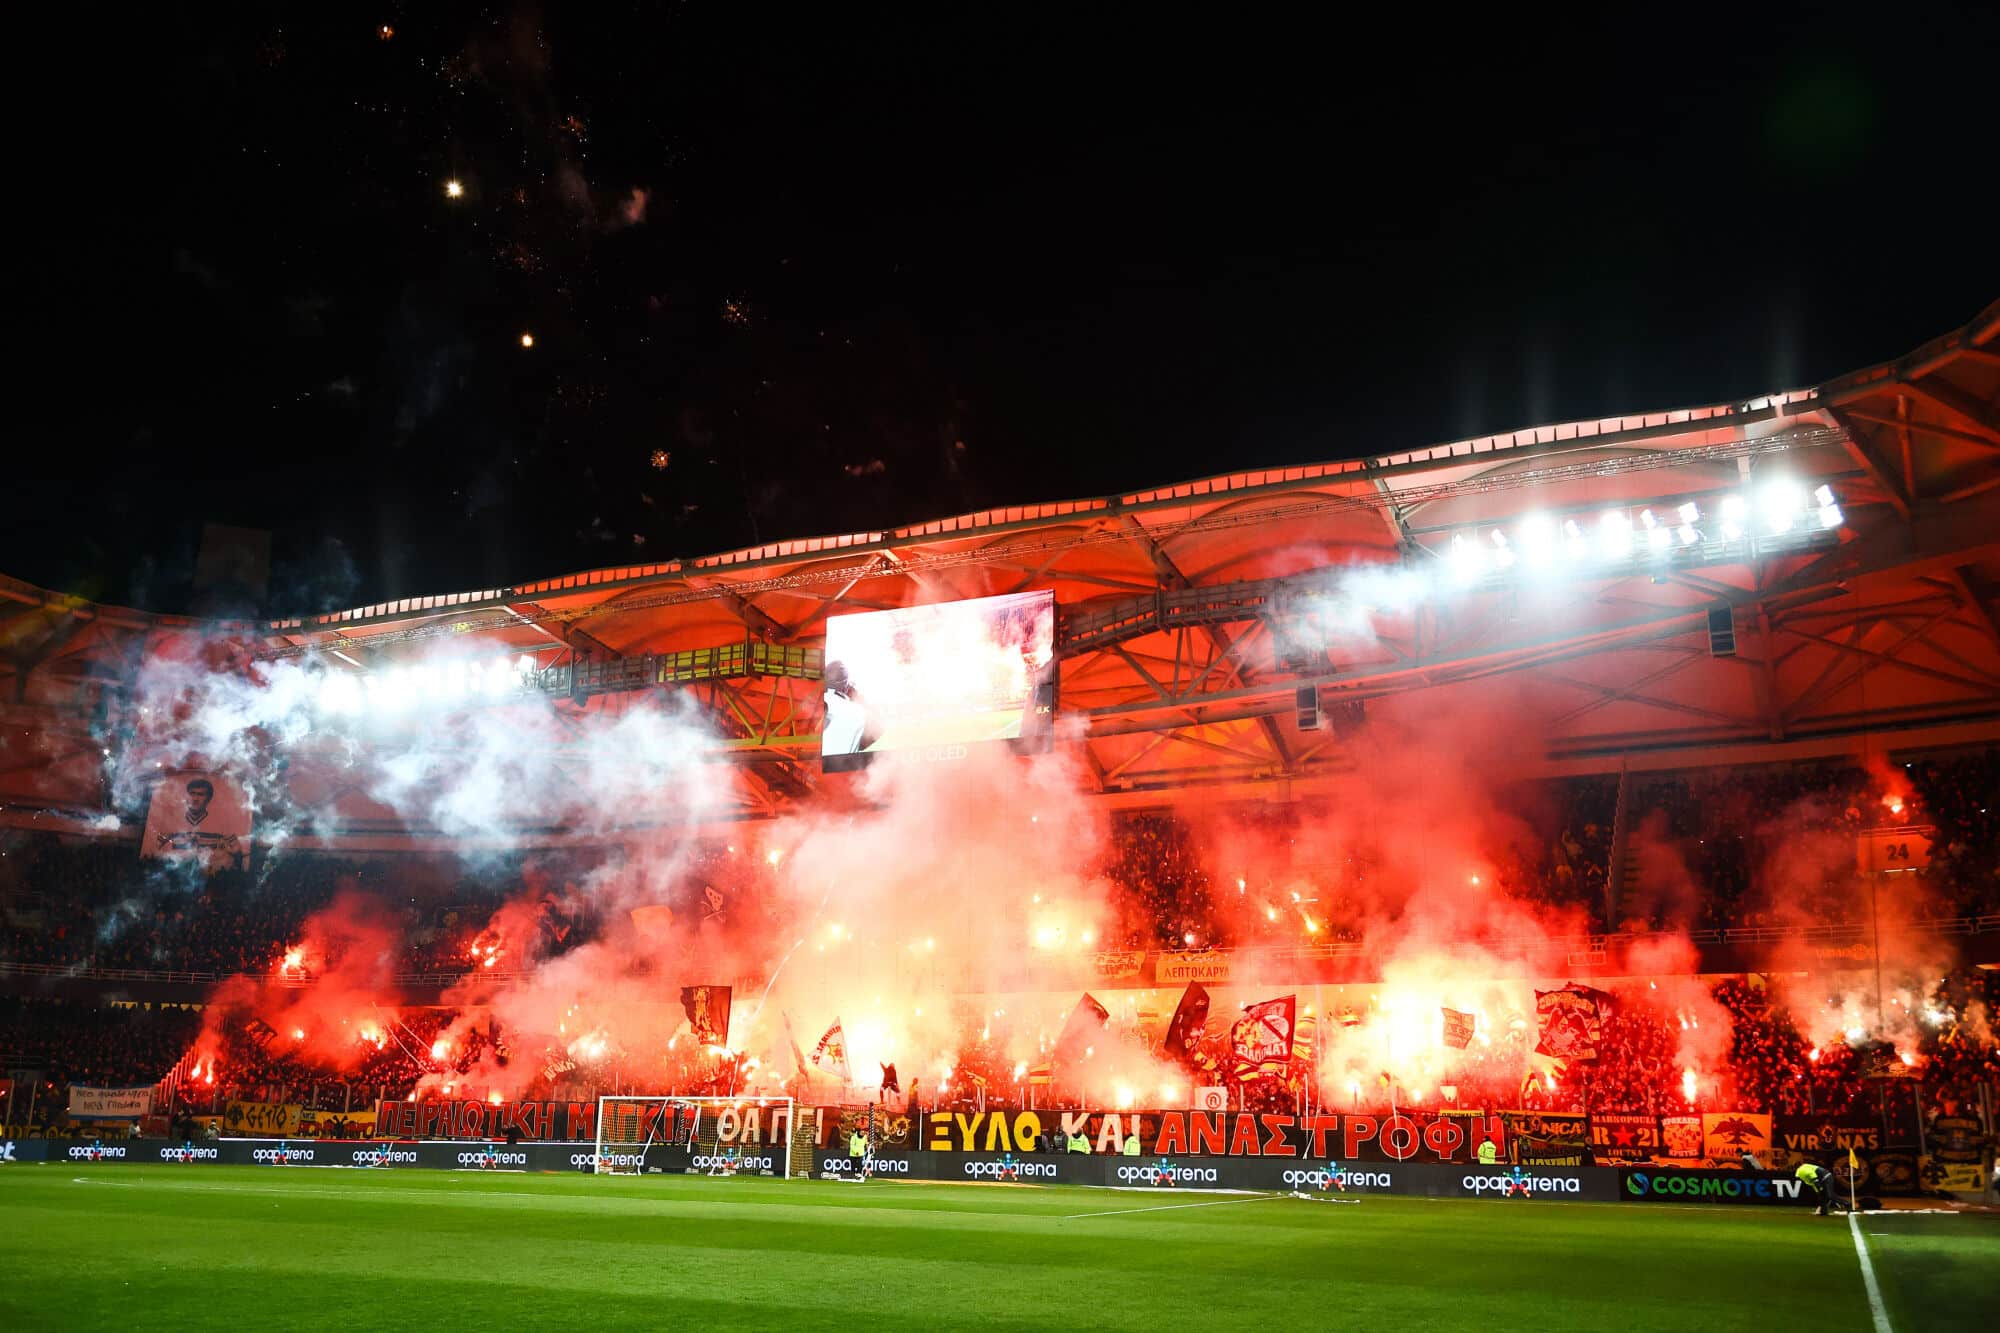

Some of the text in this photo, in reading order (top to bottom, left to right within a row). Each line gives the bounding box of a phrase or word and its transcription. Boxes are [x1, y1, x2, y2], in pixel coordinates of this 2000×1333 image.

[1886, 843, 1909, 861] 24
[378, 1100, 555, 1139] ΠΕΙΡΑΙΩΤΙΚΗ
[716, 1107, 761, 1144] ΘΑ
[1153, 1111, 1507, 1160] ΑΝΑΣΤΡΟΦΗ
[1592, 1126, 1660, 1148] R 21
[1651, 1176, 1802, 1198] COSMOTE TV
